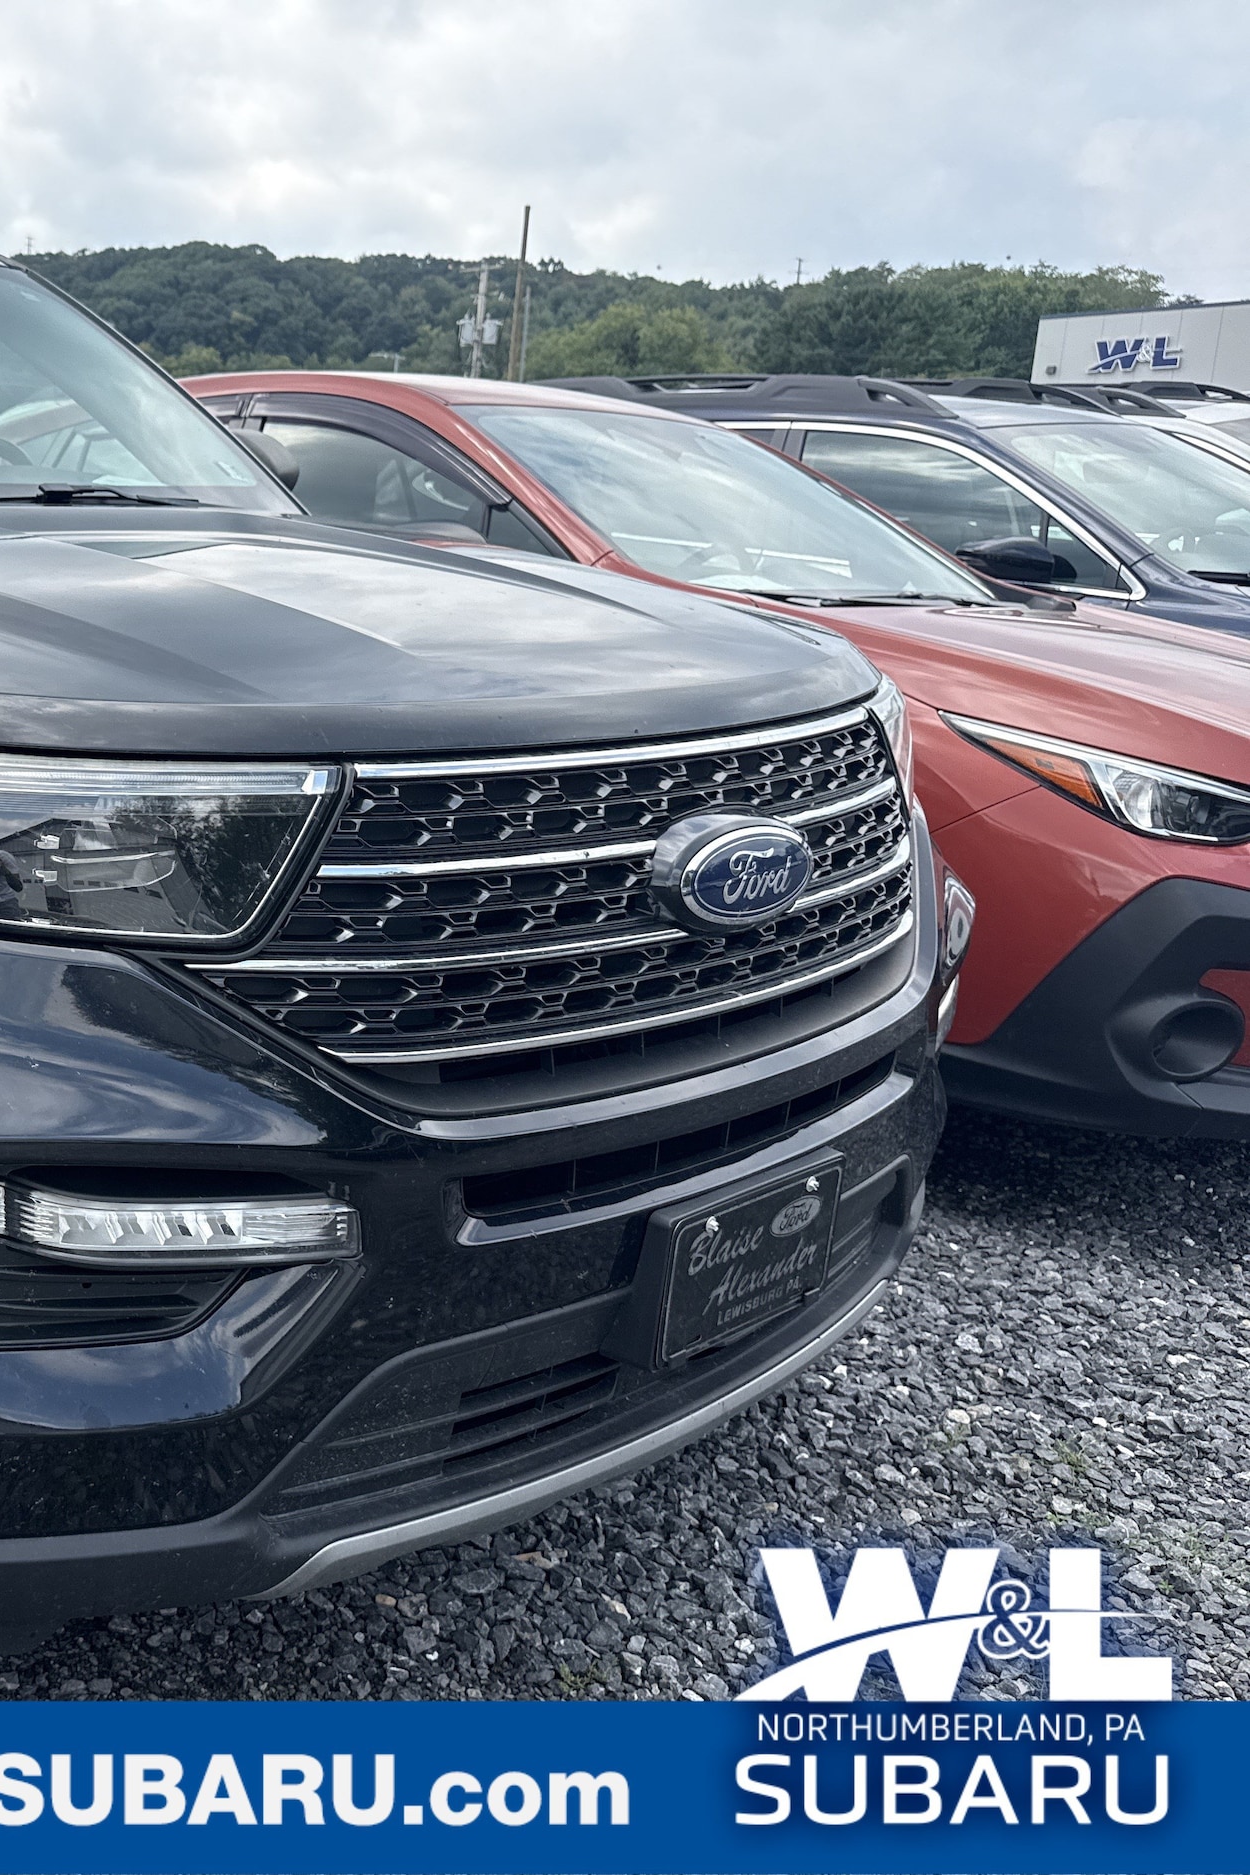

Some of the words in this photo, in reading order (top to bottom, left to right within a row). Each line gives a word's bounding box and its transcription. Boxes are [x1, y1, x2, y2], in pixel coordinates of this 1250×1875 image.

[1087, 335, 1182, 375] W&L
[723, 847, 792, 905] Ford
[780, 1202, 813, 1231] Ford
[687, 1225, 764, 1276] Blaise
[702, 1237, 818, 1316] Alexander
[716, 1285, 784, 1327] LEWISBURG
